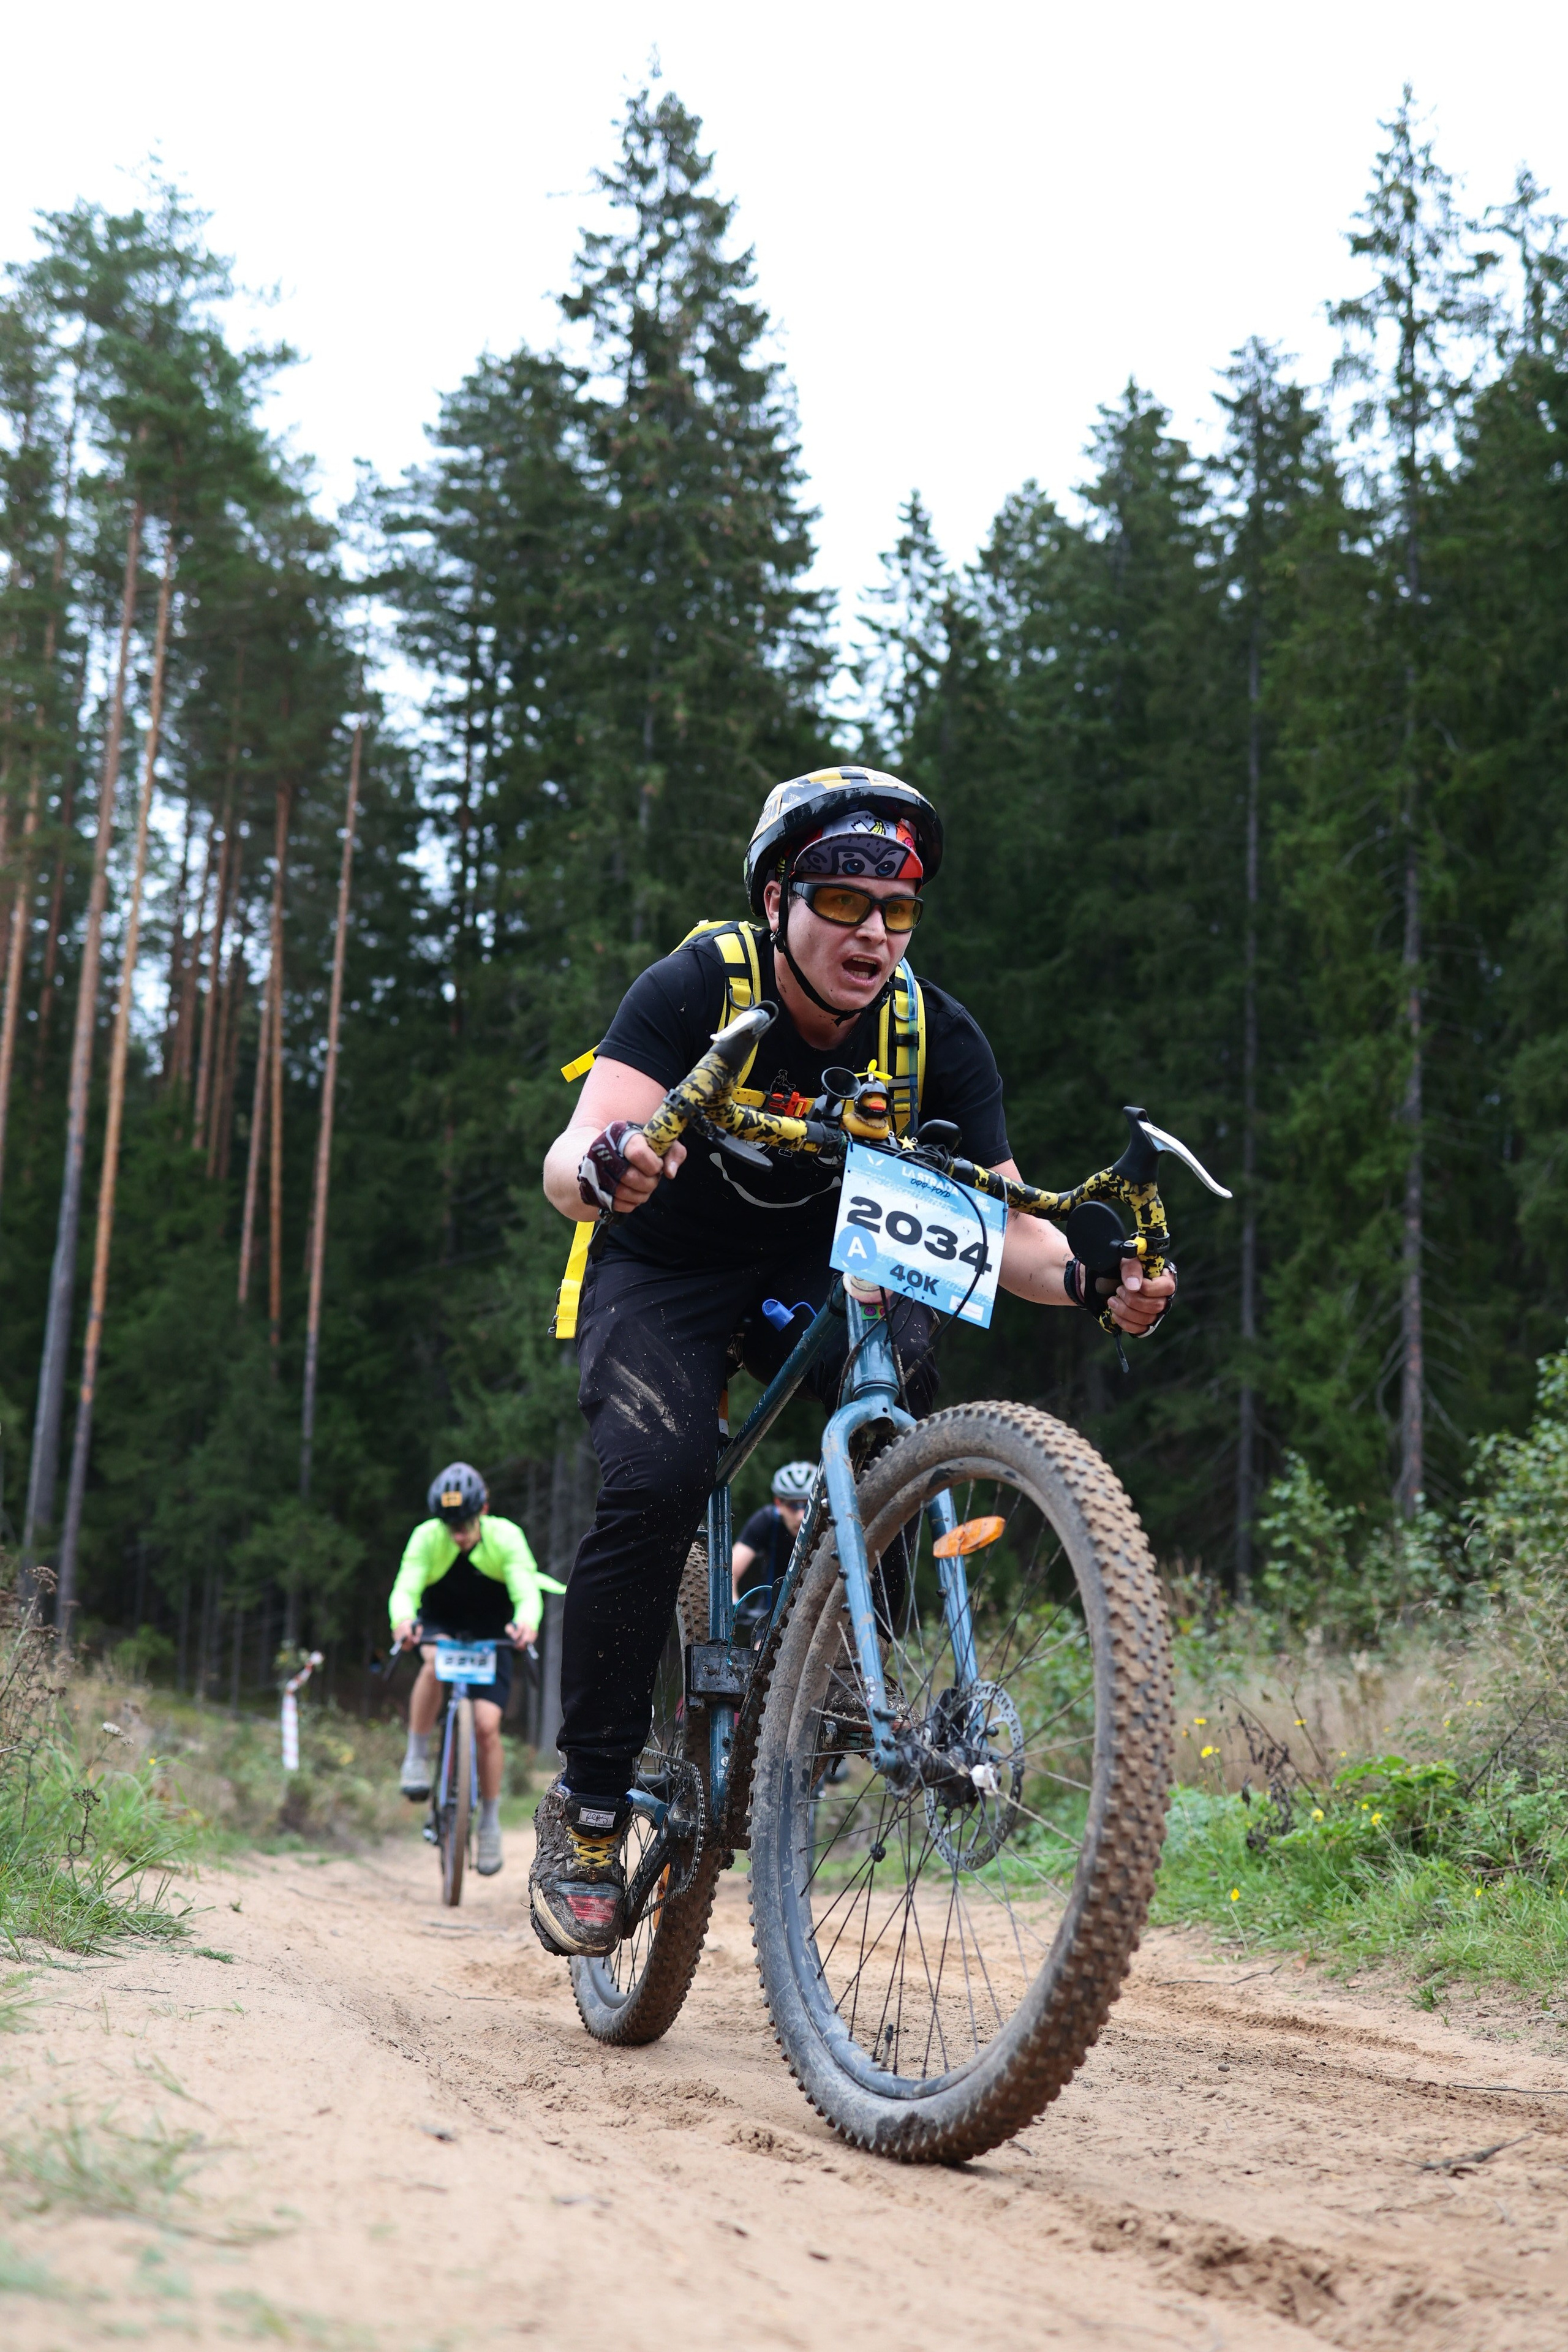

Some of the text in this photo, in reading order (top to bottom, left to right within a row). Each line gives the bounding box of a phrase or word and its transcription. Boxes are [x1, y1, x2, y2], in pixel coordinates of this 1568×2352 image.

[902, 1166, 918, 1180] LA
[918, 1172, 959, 1196] STRADA
[846, 1196, 992, 1275] 2034
[847, 1236, 867, 1259] A
[889, 1264, 939, 1296] 40K
